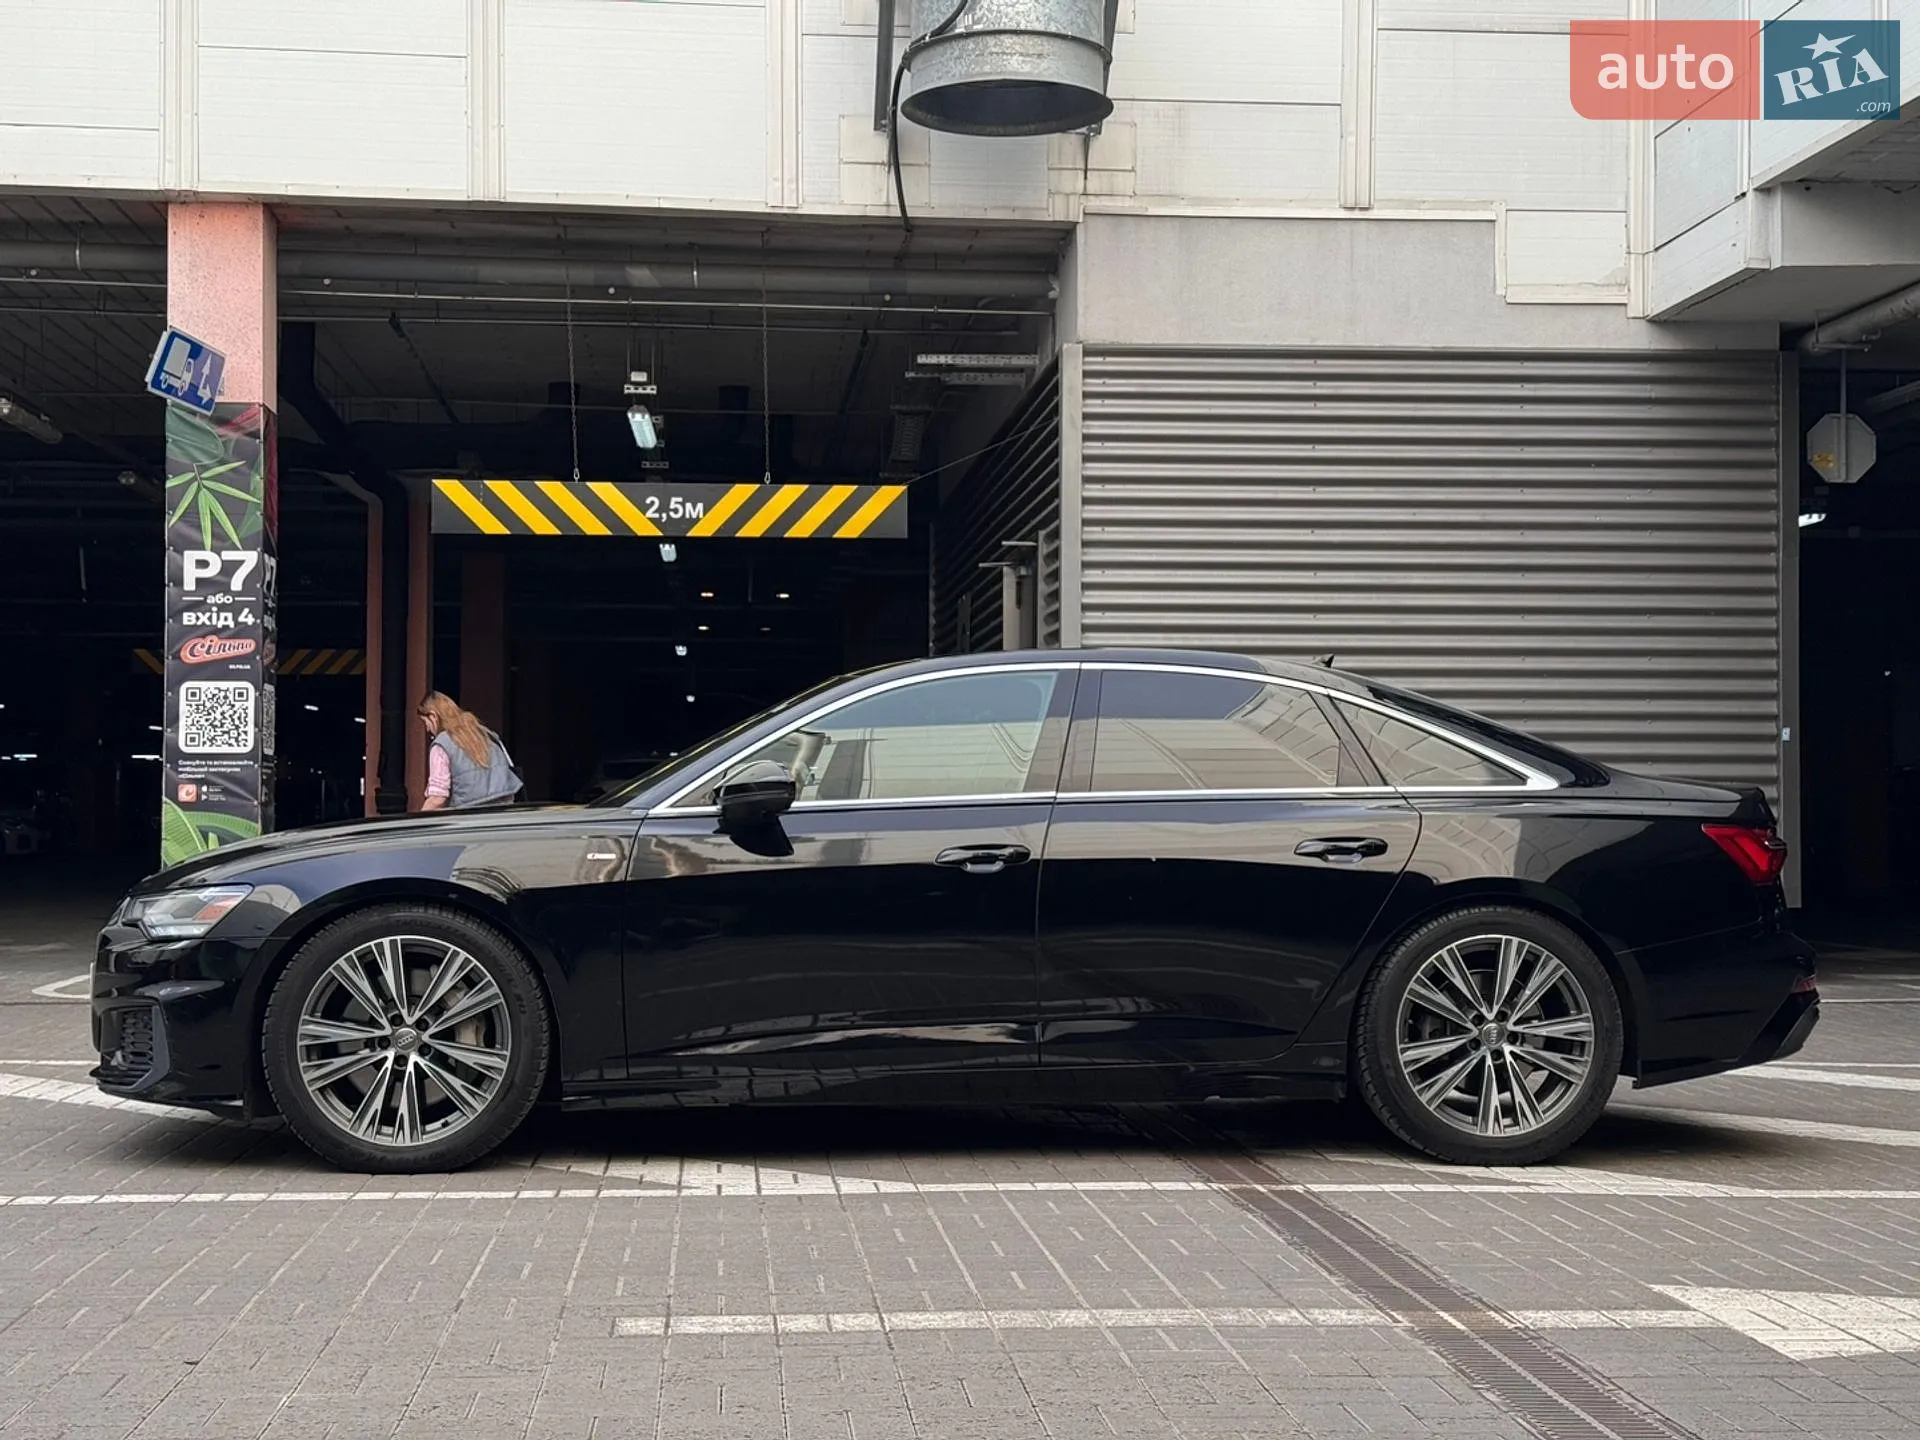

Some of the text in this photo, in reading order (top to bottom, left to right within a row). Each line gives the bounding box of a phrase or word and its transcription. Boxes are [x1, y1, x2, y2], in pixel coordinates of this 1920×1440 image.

[183, 550, 259, 591] P7
[206, 592, 233, 604] або
[182, 606, 235, 628] вхід
[238, 607, 255, 626] 4
